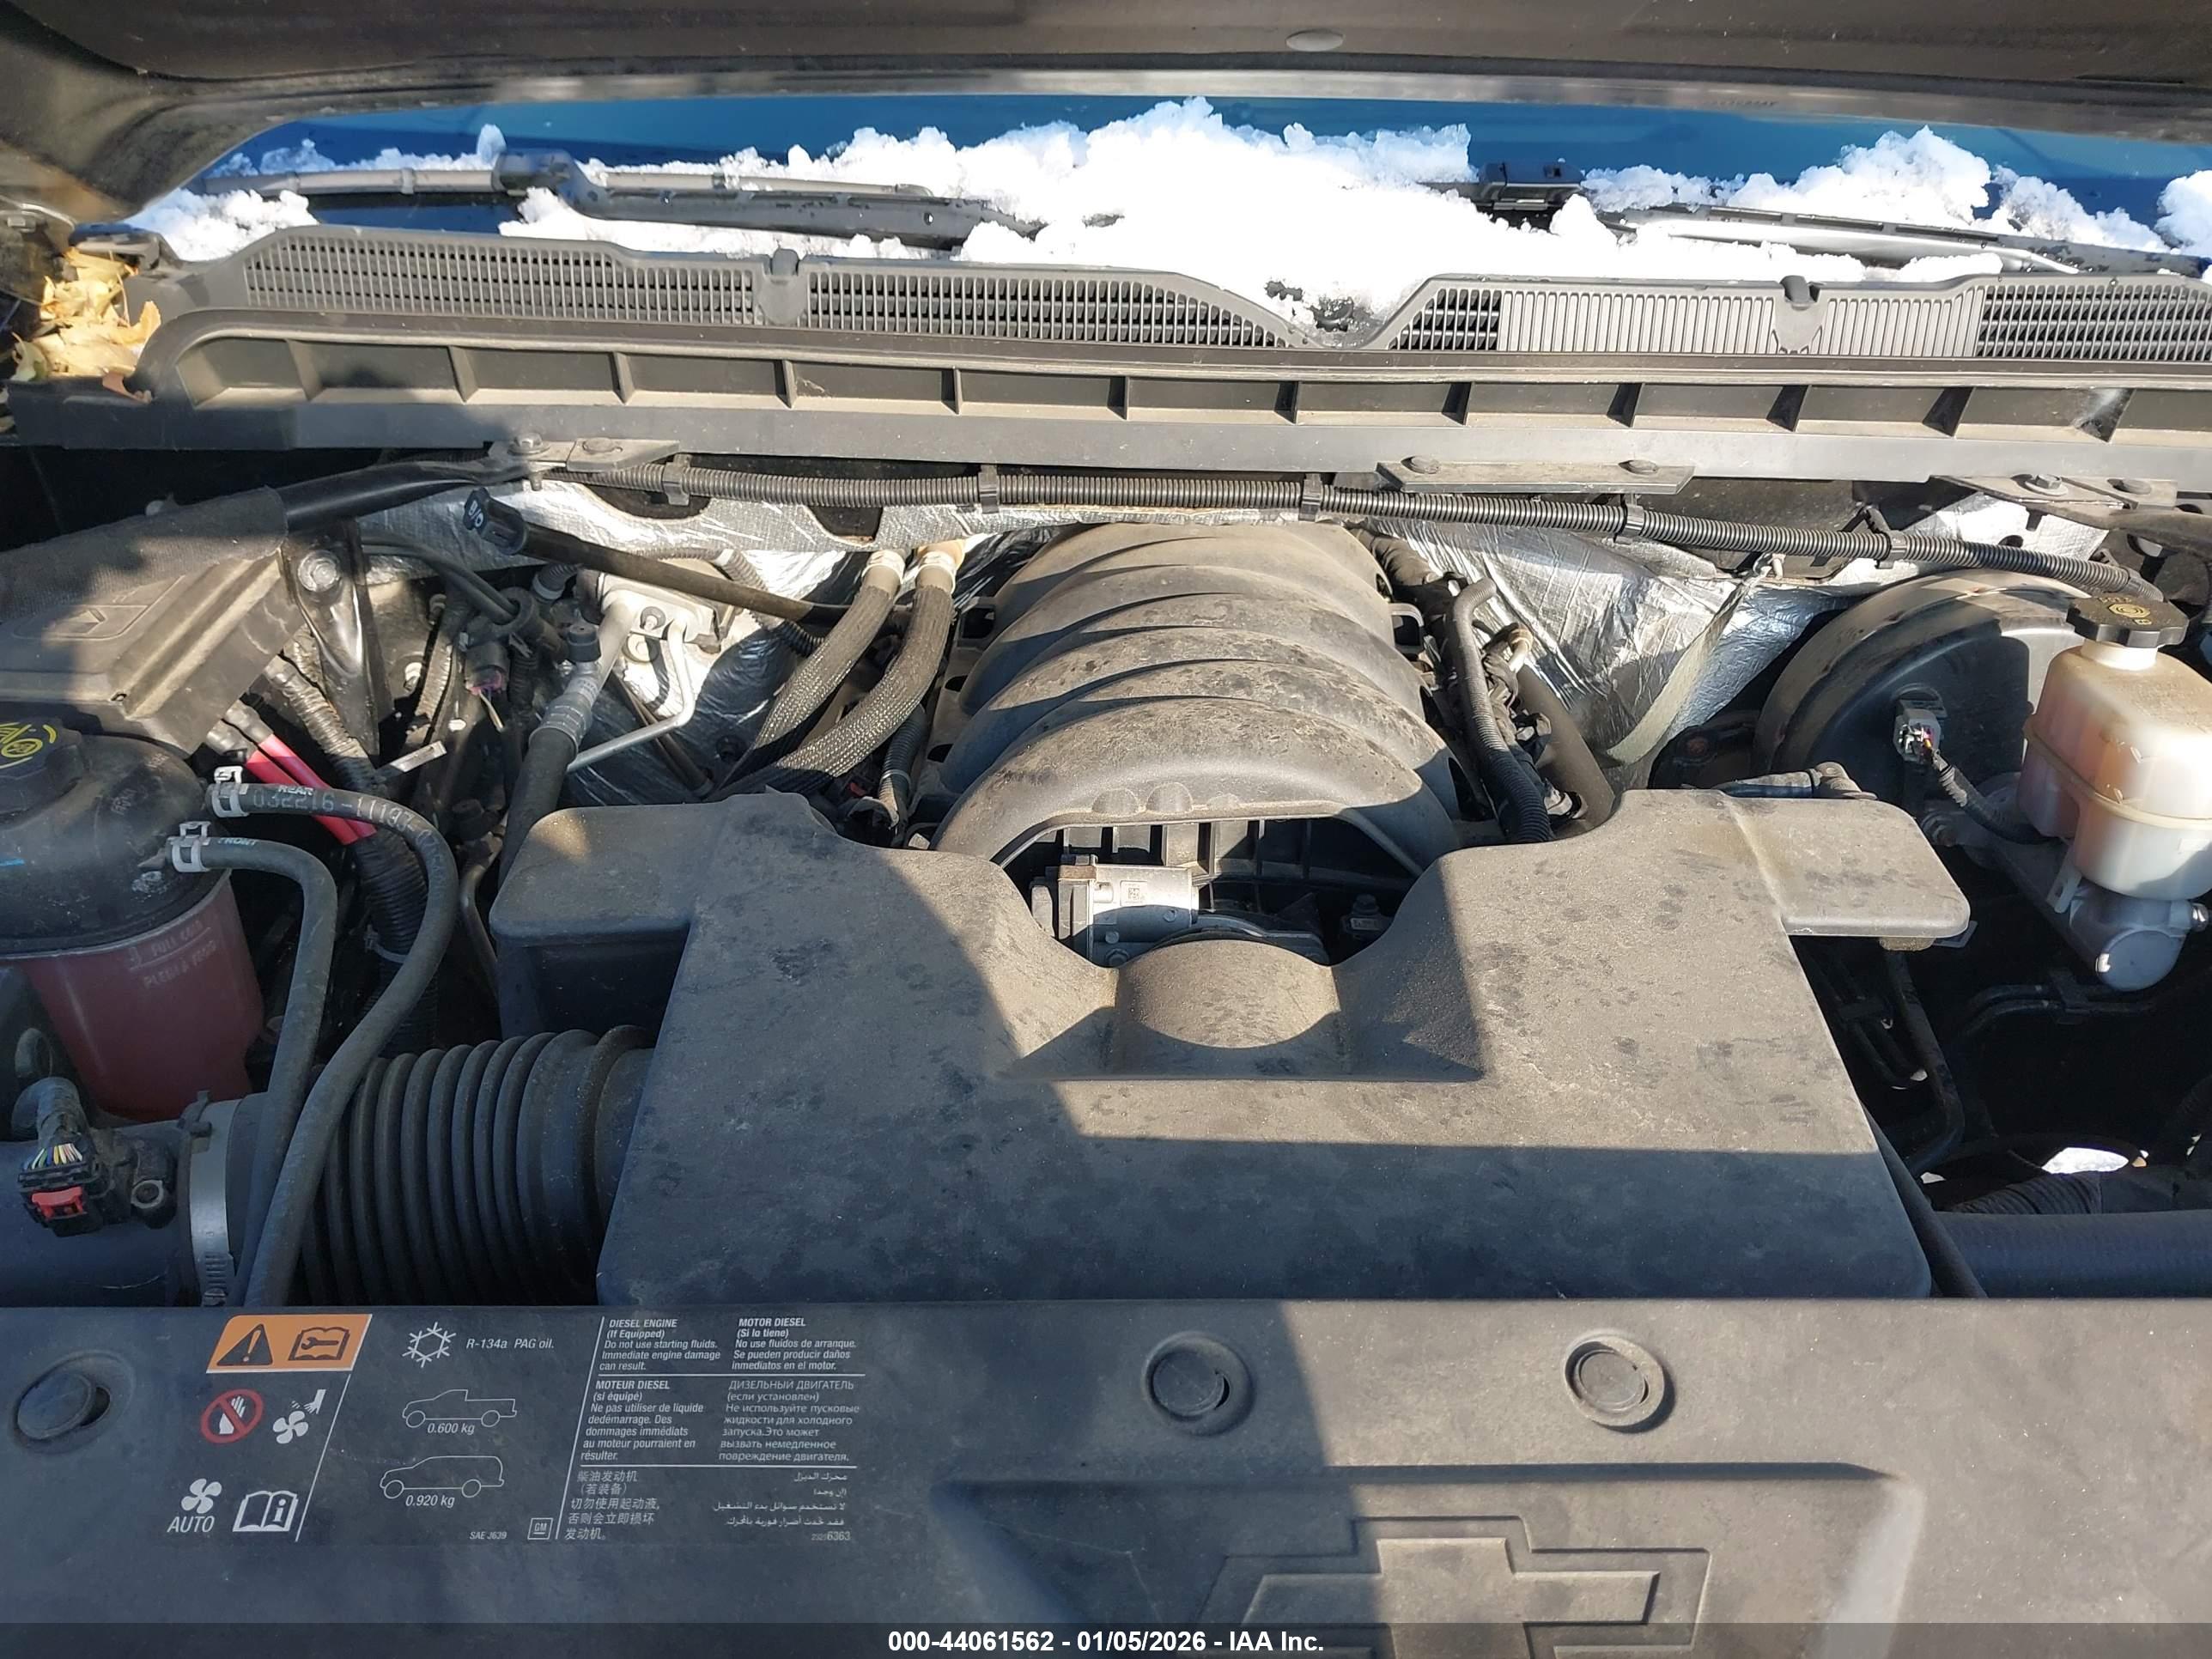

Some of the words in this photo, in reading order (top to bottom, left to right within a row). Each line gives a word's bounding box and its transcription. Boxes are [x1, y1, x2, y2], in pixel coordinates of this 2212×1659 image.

[608, 1319, 641, 1328] DIESEL
[643, 1319, 678, 1328] ENGINE
[738, 1317, 772, 1328] MOTOR
[773, 1317, 807, 1328] DIESEL
[606, 1329, 618, 1339] (If
[618, 1329, 665, 1339] Equipped)
[736, 1328, 750, 1339] (Si
[750, 1329, 762, 1338] lo
[763, 1328, 790, 1339] tiene)
[465, 1338, 507, 1349] R-134a
[514, 1338, 537, 1349] PAG
[538, 1338, 555, 1349] oil.
[604, 1340, 617, 1349] Do
[618, 1340, 634, 1349] not
[653, 1340, 689, 1350] starting
[690, 1340, 718, 1349] fluids.
[734, 1340, 748, 1348] No
[768, 1340, 799, 1348] fluidos
[800, 1340, 813, 1348] de
[814, 1340, 857, 1350] arranque.
[601, 1351, 649, 1359] Immediate
[651, 1351, 683, 1360] engine
[684, 1350, 721, 1360] damage
[732, 1350, 745, 1358] Se
[746, 1350, 781, 1360] pueden
[782, 1350, 822, 1360] producir
[823, 1350, 851, 1358] daños
[617, 1362, 647, 1370] result.
[731, 1360, 781, 1370] inmediatos
[783, 1362, 795, 1370] en
[797, 1360, 807, 1370] el
[808, 1360, 837, 1370] motor.
[595, 1380, 635, 1389] MOTEUR
[636, 1380, 671, 1389] DIESEL
[728, 1380, 794, 1390] ДИЗЕЛЬНЫЙ
[795, 1380, 854, 1390] ДВИГАТЕЛЬ
[592, 1391, 605, 1402] (si
[606, 1391, 643, 1402] équipé)
[726, 1391, 755, 1402] (если
[756, 1391, 820, 1402] установлен)
[590, 1403, 605, 1412] Ne
[605, 1405, 623, 1413] pas
[624, 1403, 657, 1412] utiliser
[659, 1403, 672, 1412] de
[672, 1403, 704, 1413] liquide
[725, 1403, 740, 1413] Не
[742, 1403, 807, 1414] используйте
[810, 1405, 860, 1414] пусковые
[653, 1415, 672, 1424] Des
[723, 1417, 775, 1425] жидкости
[775, 1417, 795, 1425] для
[797, 1417, 854, 1425] холодного
[427, 1423, 459, 1434] 0.600
[459, 1423, 476, 1435] kg
[585, 1426, 638, 1437] dommages
[639, 1426, 689, 1436] immédiats
[597, 1439, 632, 1448] moteur
[632, 1439, 683, 1449] pourraient
[720, 1441, 763, 1449] вызвать
[764, 1441, 837, 1449] немедленное
[580, 1451, 618, 1460] résulter.
[576, 1470, 638, 1482] 柴油发动机
[404, 1494, 438, 1506] 0.920
[440, 1494, 456, 1509] kg
[567, 1512, 655, 1525] 否则会立即损坏
[167, 1516, 215, 1534] AUTO
[534, 1523, 548, 1532] GM
